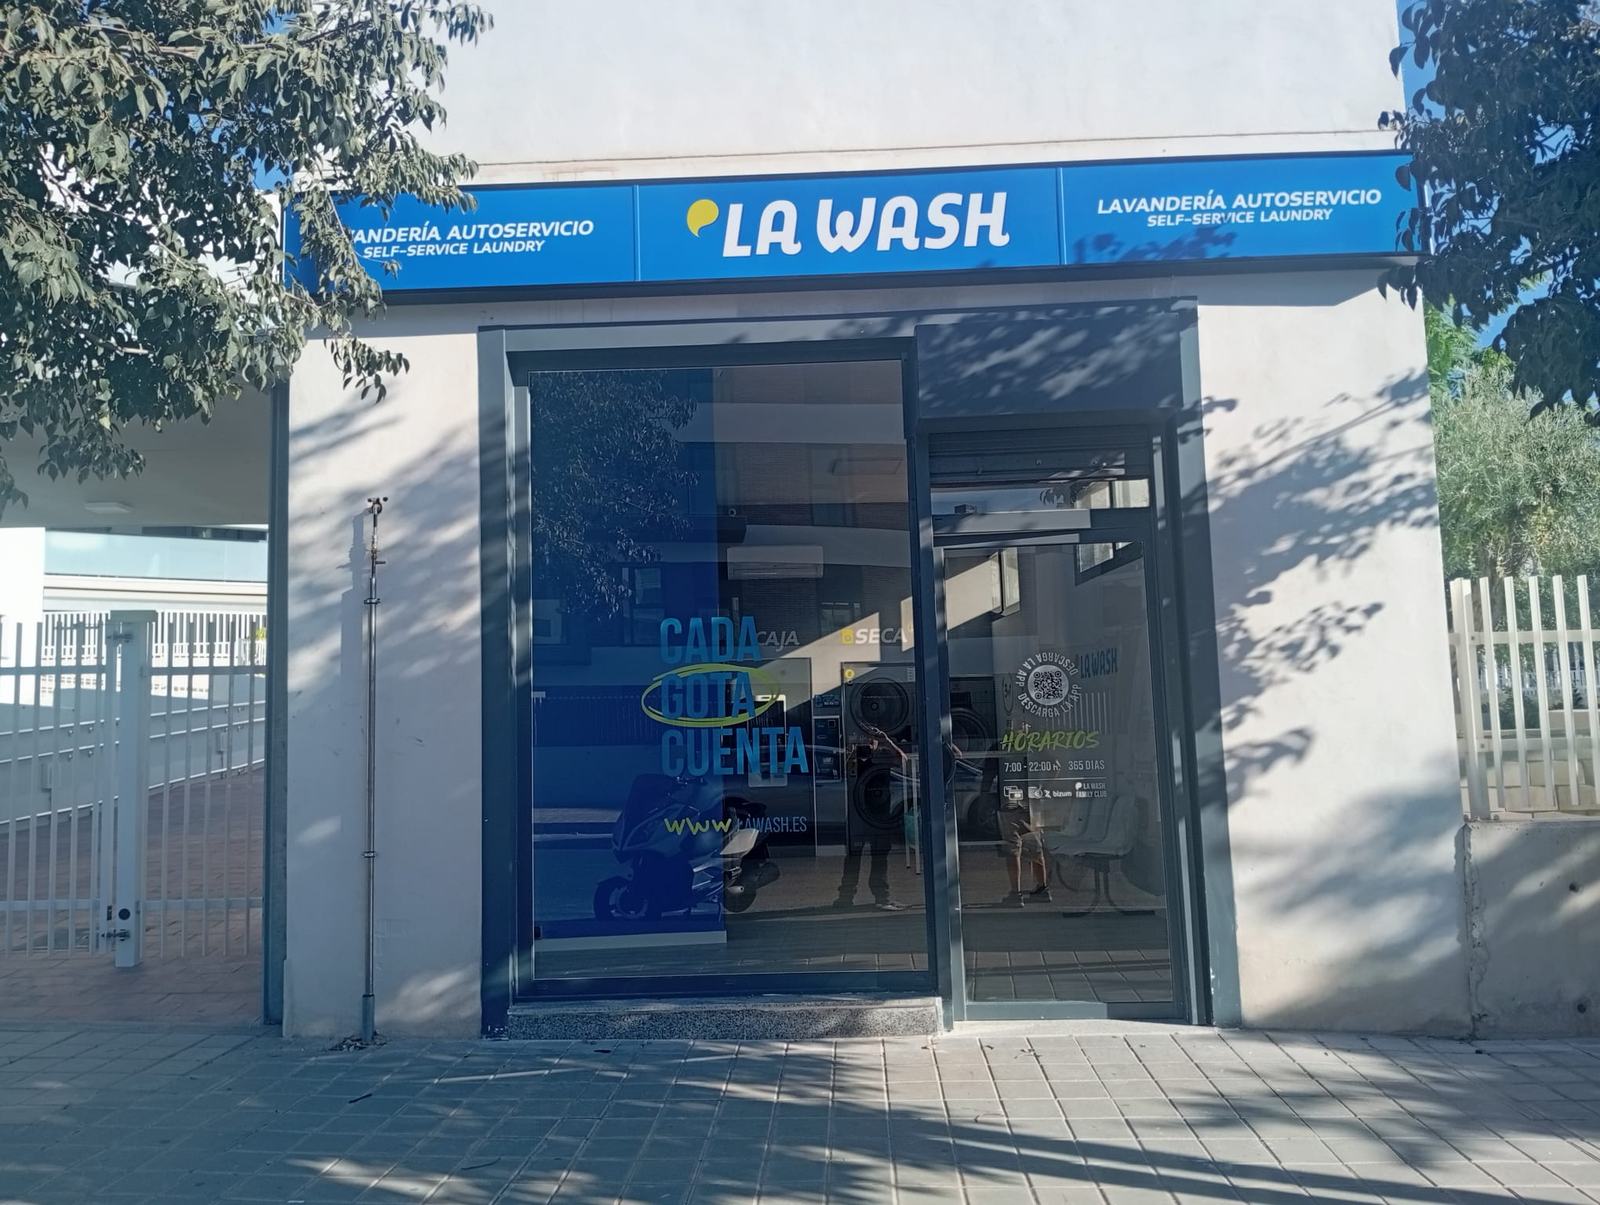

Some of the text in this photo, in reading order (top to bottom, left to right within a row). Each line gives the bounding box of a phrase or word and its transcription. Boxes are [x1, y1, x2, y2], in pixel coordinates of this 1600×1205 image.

[1097, 189, 1382, 214] LAVANDERÍA AUTOSERVICIO
[722, 192, 1010, 257] LA WASH
[1147, 208, 1333, 227] SELF-SERVICE LAUNDRY
[350, 219, 594, 244] ANDERÍA AUTOSERVICIO
[363, 240, 545, 259] SELF-SERVICE LAUNDRY
[660, 616, 761, 665] CADA
[1015, 652, 1079, 687] DESCARGA LA APP
[660, 671, 757, 720] GOTA
[1018, 692, 1061, 718] DESCARGA
[661, 726, 810, 778] CUENTA
[1000, 730, 1100, 752] HORARIOS
[1004, 762, 1022, 772] 7:00
[1029, 761, 1051, 772] 22:00
[1068, 760, 1083, 770] 365
